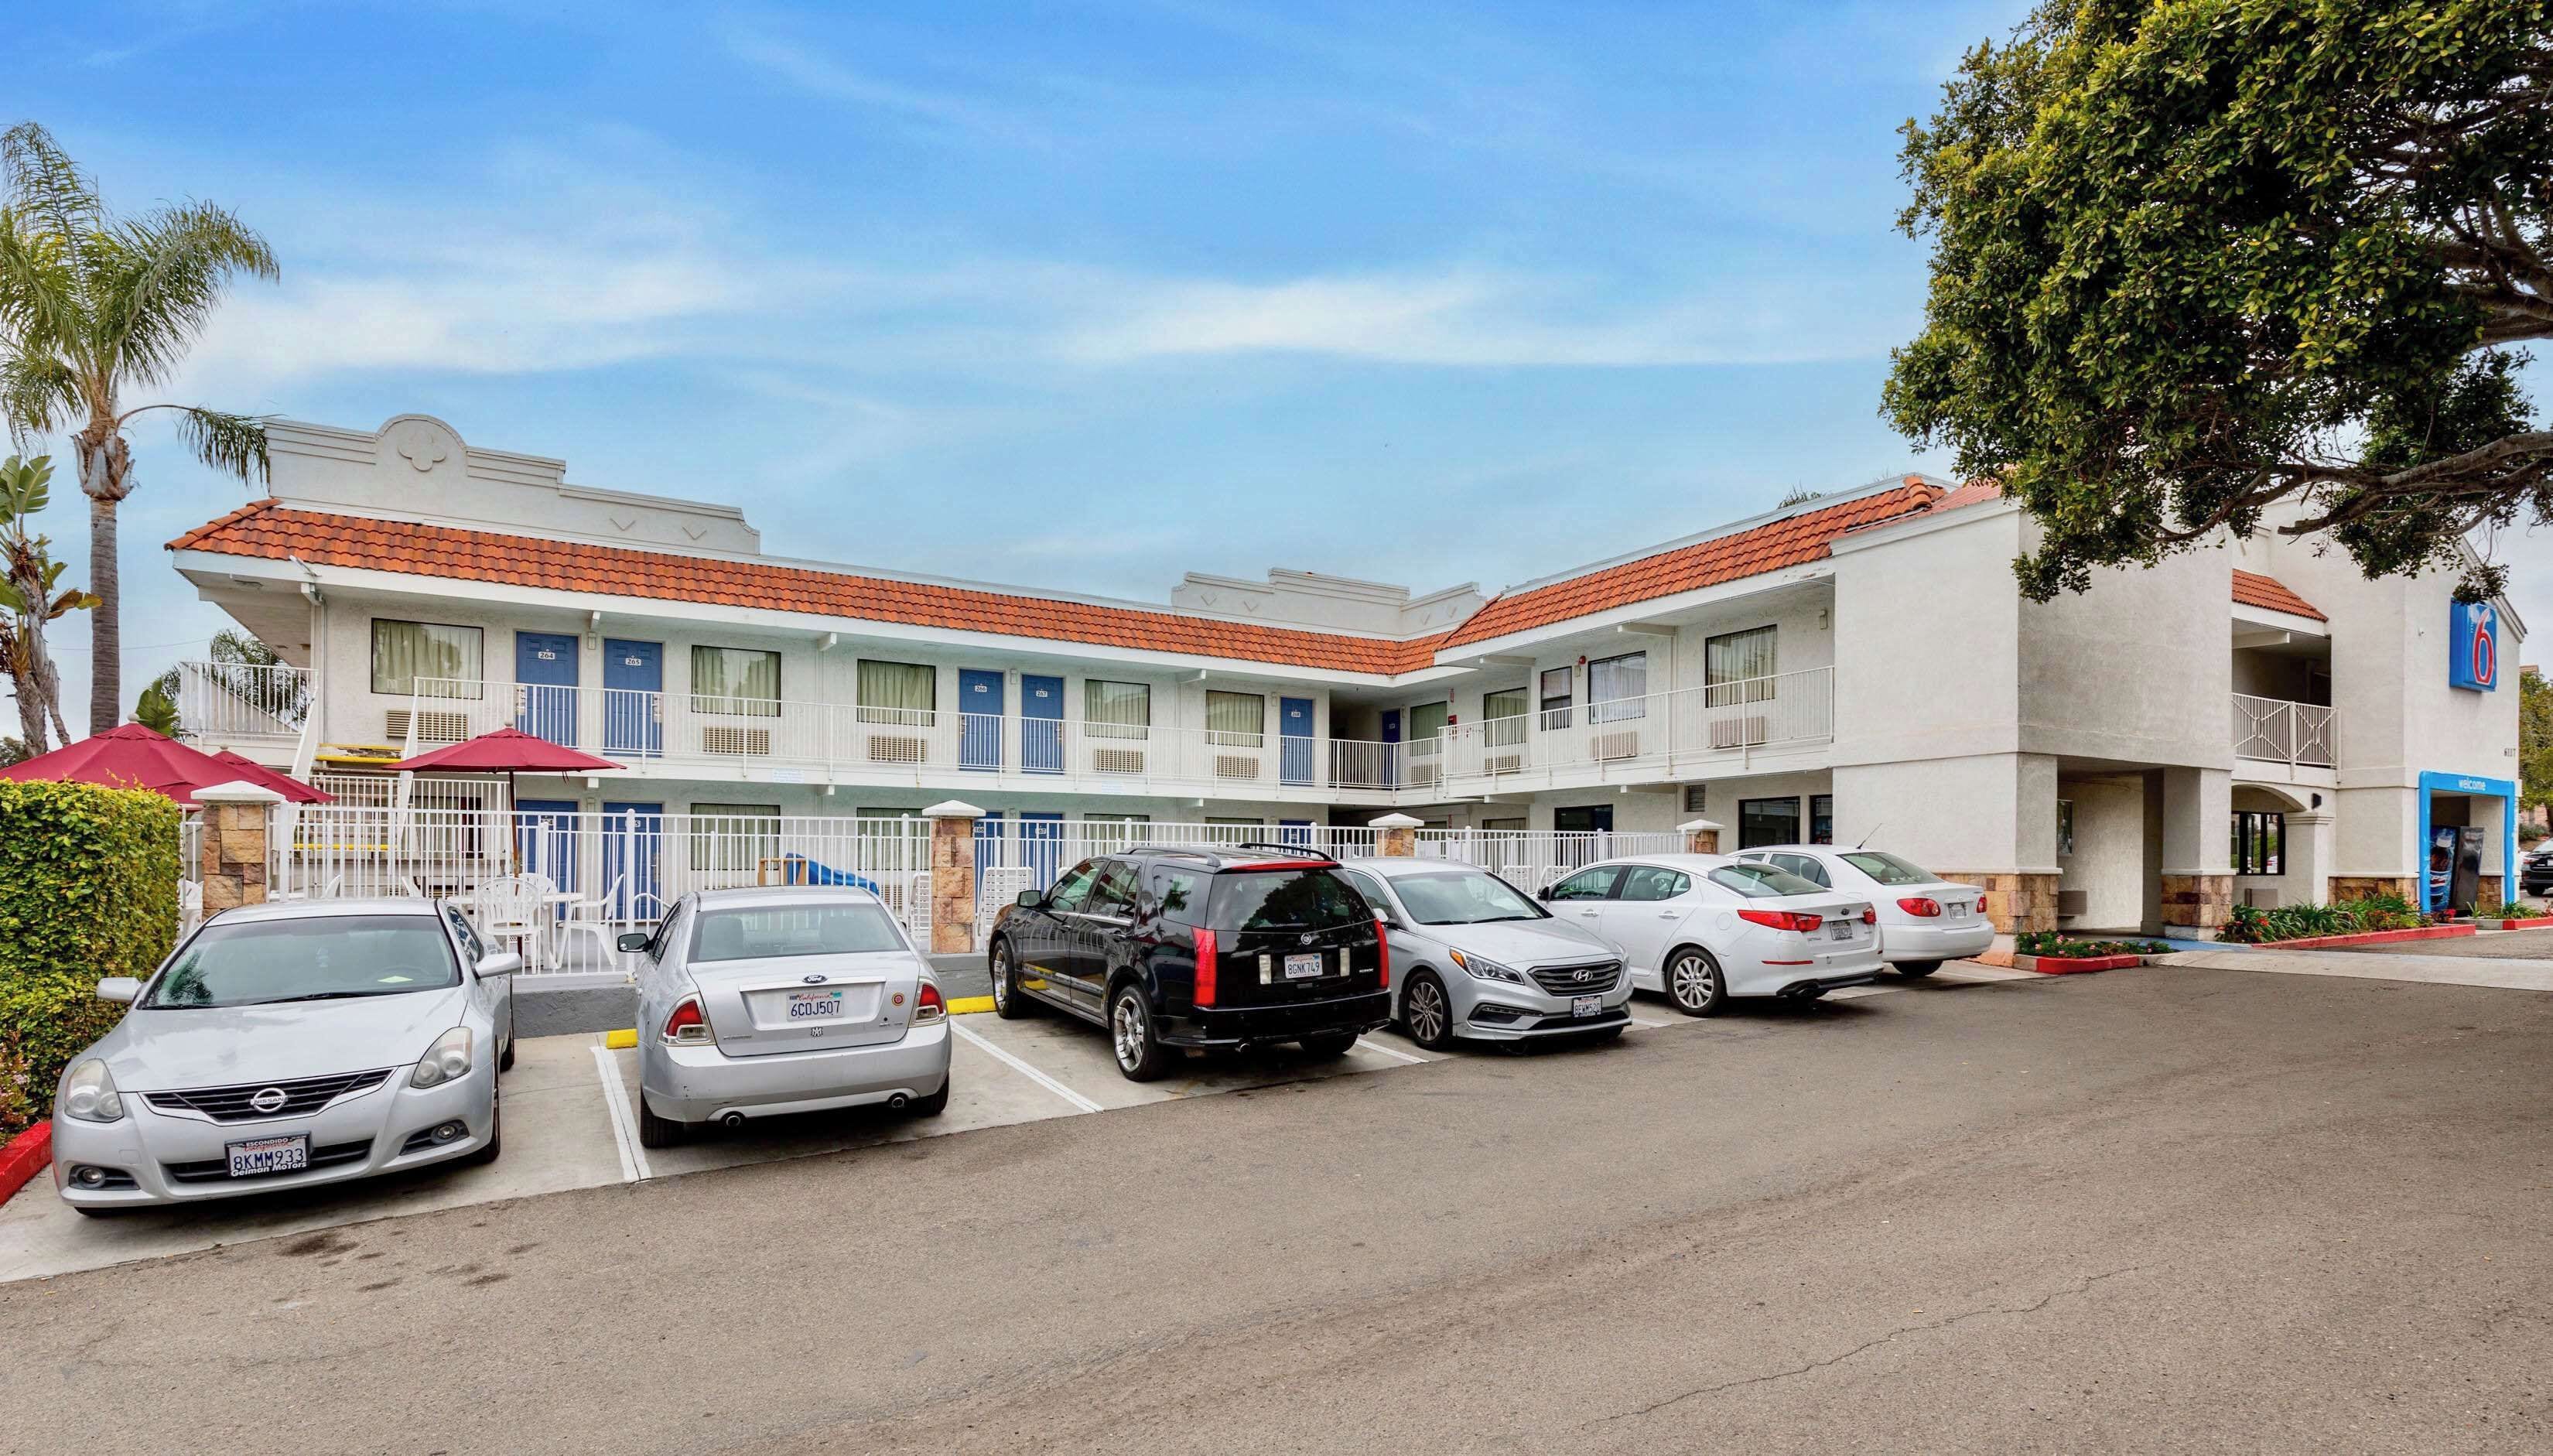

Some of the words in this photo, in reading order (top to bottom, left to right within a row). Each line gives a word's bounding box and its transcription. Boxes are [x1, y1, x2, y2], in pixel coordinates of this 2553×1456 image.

[2473, 607, 2494, 685] 6
[2459, 777, 2486, 791] welcome
[1288, 962, 1320, 975] 8GNK749
[798, 993, 832, 1002] California
[254, 1096, 285, 1106] NISSAN
[246, 1137, 289, 1147] ESCONDIDO
[234, 1148, 304, 1171] 8KMM933
